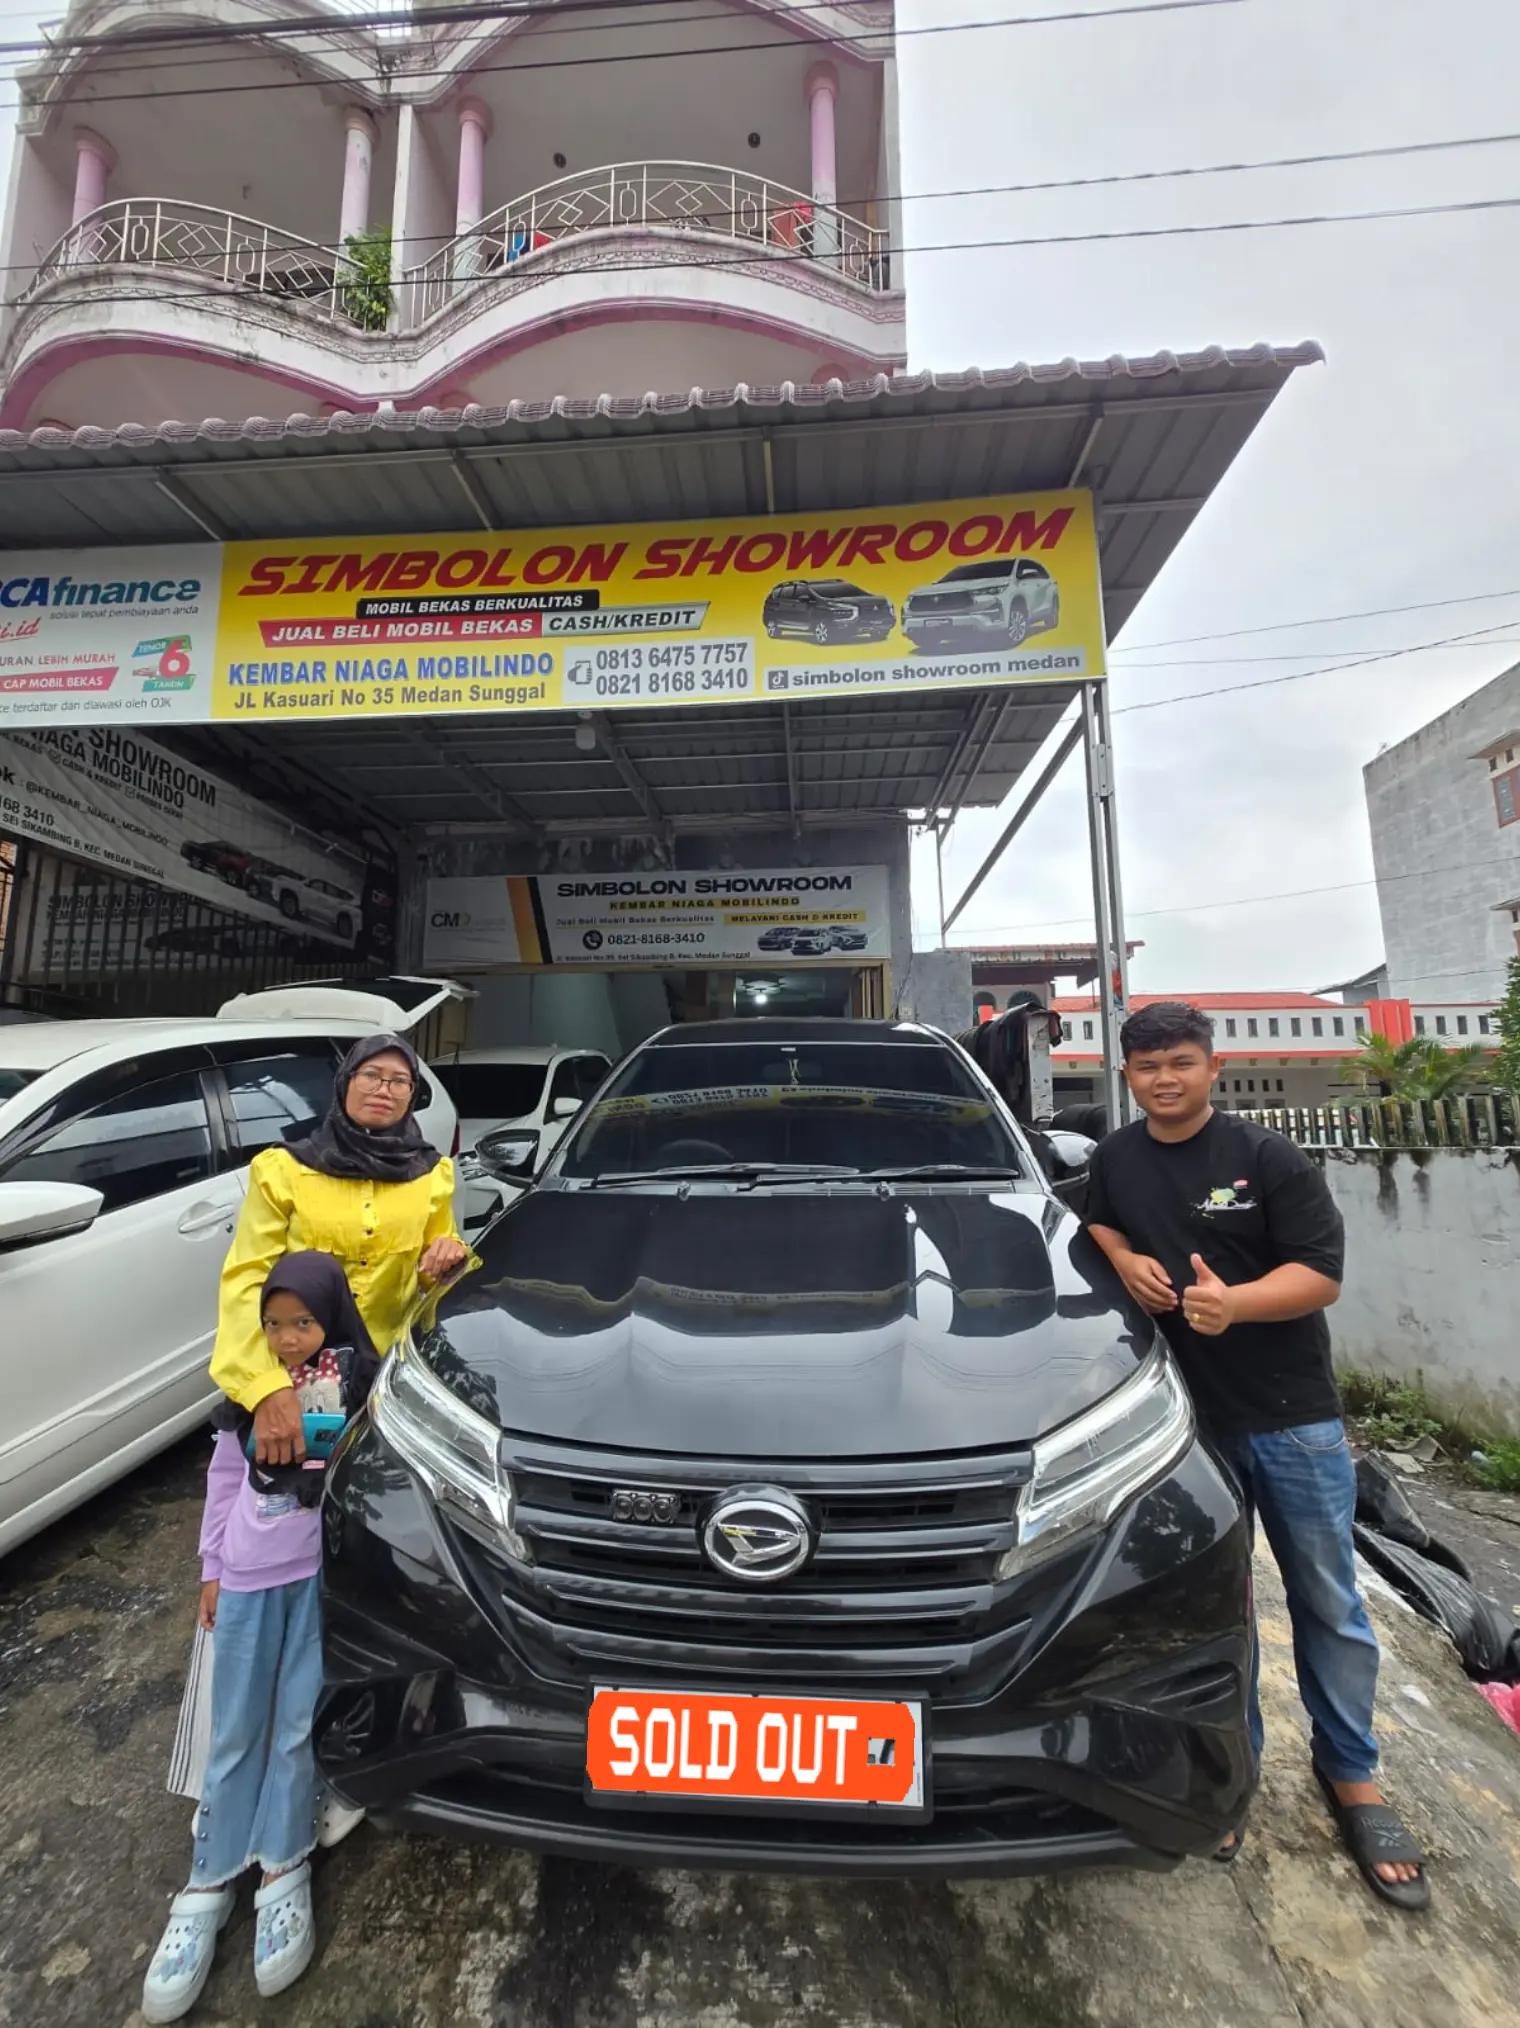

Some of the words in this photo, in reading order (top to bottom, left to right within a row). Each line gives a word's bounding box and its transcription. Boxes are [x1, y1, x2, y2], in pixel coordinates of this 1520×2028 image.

[238, 541, 629, 597] SIMBOLON
[633, 507, 1075, 581] SHOWROOM
[0, 577, 50, 608] CA
[365, 600, 415, 616] MOBIL
[417, 598, 471, 613] BEKAS
[474, 594, 583, 612] BERKUALITAS
[272, 623, 326, 641] JUAL
[332, 621, 382, 640] BELI
[387, 619, 455, 638] MOBIL
[461, 616, 534, 635] BEKAS
[548, 610, 695, 632] CASH/KREDIT
[38, 655, 69, 665] LEBIH
[72, 654, 116, 664] MURAH
[159, 639, 190, 679] 6
[229, 659, 326, 686] KEMBAR
[334, 657, 410, 685] NIAGA
[416, 653, 555, 682] MOBILINDO
[595, 648, 645, 671] 0813
[648, 646, 696, 668] 6475
[700, 643, 749, 666] 7757
[793, 667, 885, 687] simbolon
[892, 662, 1001, 680] showroom
[1008, 654, 1081, 673] medan
[29, 678, 63, 688] MOBIL
[67, 676, 103, 687] BEKAS
[234, 690, 257, 709] JL
[262, 689, 334, 708] Kasuari
[341, 689, 366, 706] No
[371, 687, 395, 704] 35
[401, 684, 463, 703] Medan
[469, 682, 547, 705] Sunggal
[595, 674, 645, 696] 0821
[648, 671, 696, 693] 8168
[700, 668, 749, 691] 3410
[61, 701, 80, 711] dan
[151, 698, 171, 708] OJK
[88, 728, 216, 807] SHOWROOM
[93, 749, 184, 808] MOBILINDO
[2, 813, 19, 826] SEI
[23, 805, 54, 827] 3410
[557, 879, 686, 898] SIMBOLON
[694, 876, 852, 894] SHOWROOM
[610, 900, 665, 910] KEMBAR
[672, 899, 714, 908] NIAGA
[721, 897, 800, 908] MOBILINDO
[607, 932, 705, 945] 0821-8168-3410
